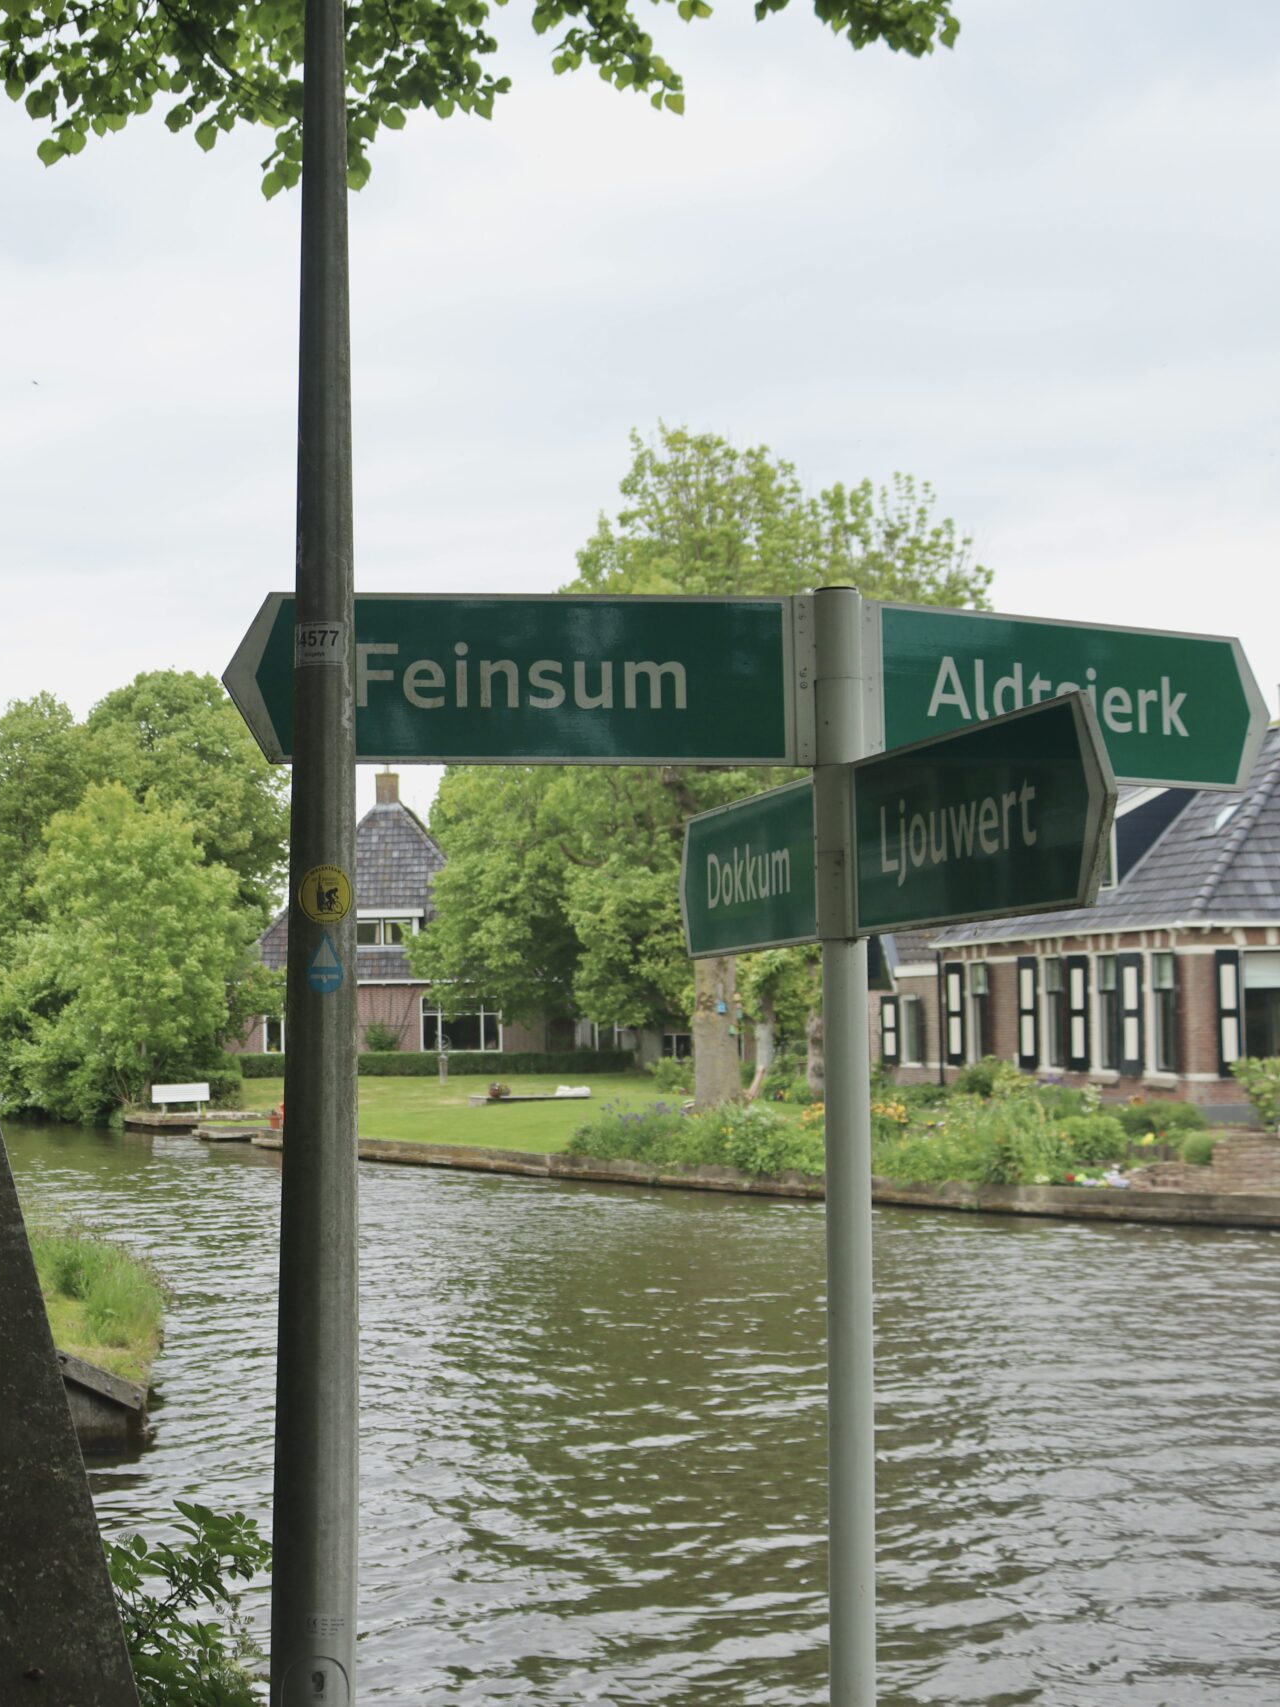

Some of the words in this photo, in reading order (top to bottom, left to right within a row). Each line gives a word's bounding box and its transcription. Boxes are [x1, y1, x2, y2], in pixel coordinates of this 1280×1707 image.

[355, 641, 688, 710] Feinsum
[927, 655, 1190, 737] Aldterk
[880, 776, 1037, 888] Ljouwert
[707, 843, 790, 910] Dokkum
